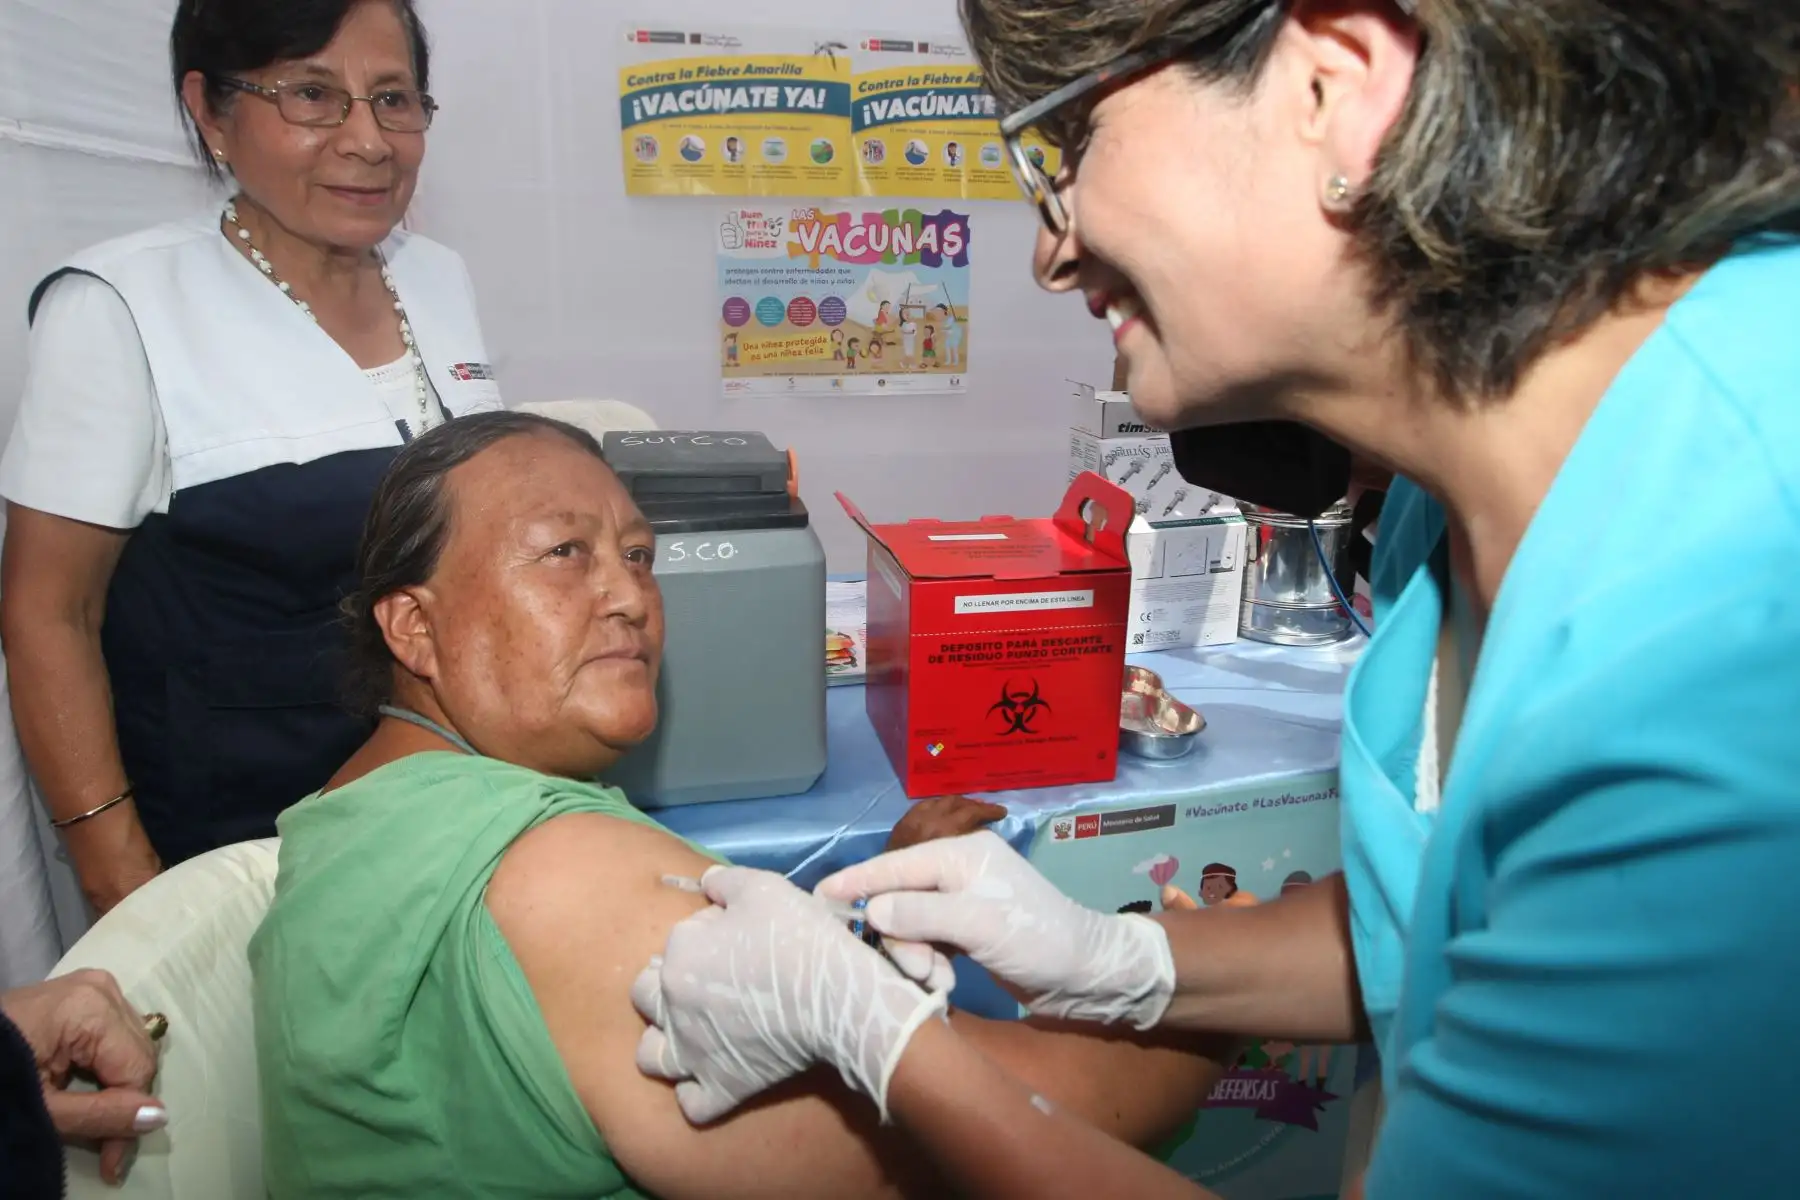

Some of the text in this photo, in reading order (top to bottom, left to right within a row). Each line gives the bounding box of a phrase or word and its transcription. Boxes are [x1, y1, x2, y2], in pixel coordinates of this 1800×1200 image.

[627, 63, 803, 88] Contra la Fiebre Amarilla
[858, 78, 905, 94] Contra
[907, 75, 920, 86] la
[922, 73, 963, 85] Fiebre
[633, 84, 827, 121] ¡VACÚNATE YA!
[863, 90, 996, 126] ¡VACÚNATE
[791, 209, 815, 221] LAS
[797, 222, 963, 257] VACUNAS
[743, 341, 759, 351] Una
[785, 336, 828, 350] protegida
[974, 600, 999, 608] LLENAR
[1015, 598, 1039, 606] ENCIMA
[1050, 596, 1065, 604] ESTA
[1006, 639, 1037, 650] PARA
[1041, 634, 1103, 647] DESCARTE
[928, 655, 943, 664] DE
[948, 652, 1003, 664] RESIDUO
[1006, 649, 1048, 660] PUNZO
[1051, 644, 1113, 657] CORTANTE
[1185, 801, 1249, 819] #Vacúnate
[1077, 812, 1160, 831] PERÚ Ministerio de Salud
